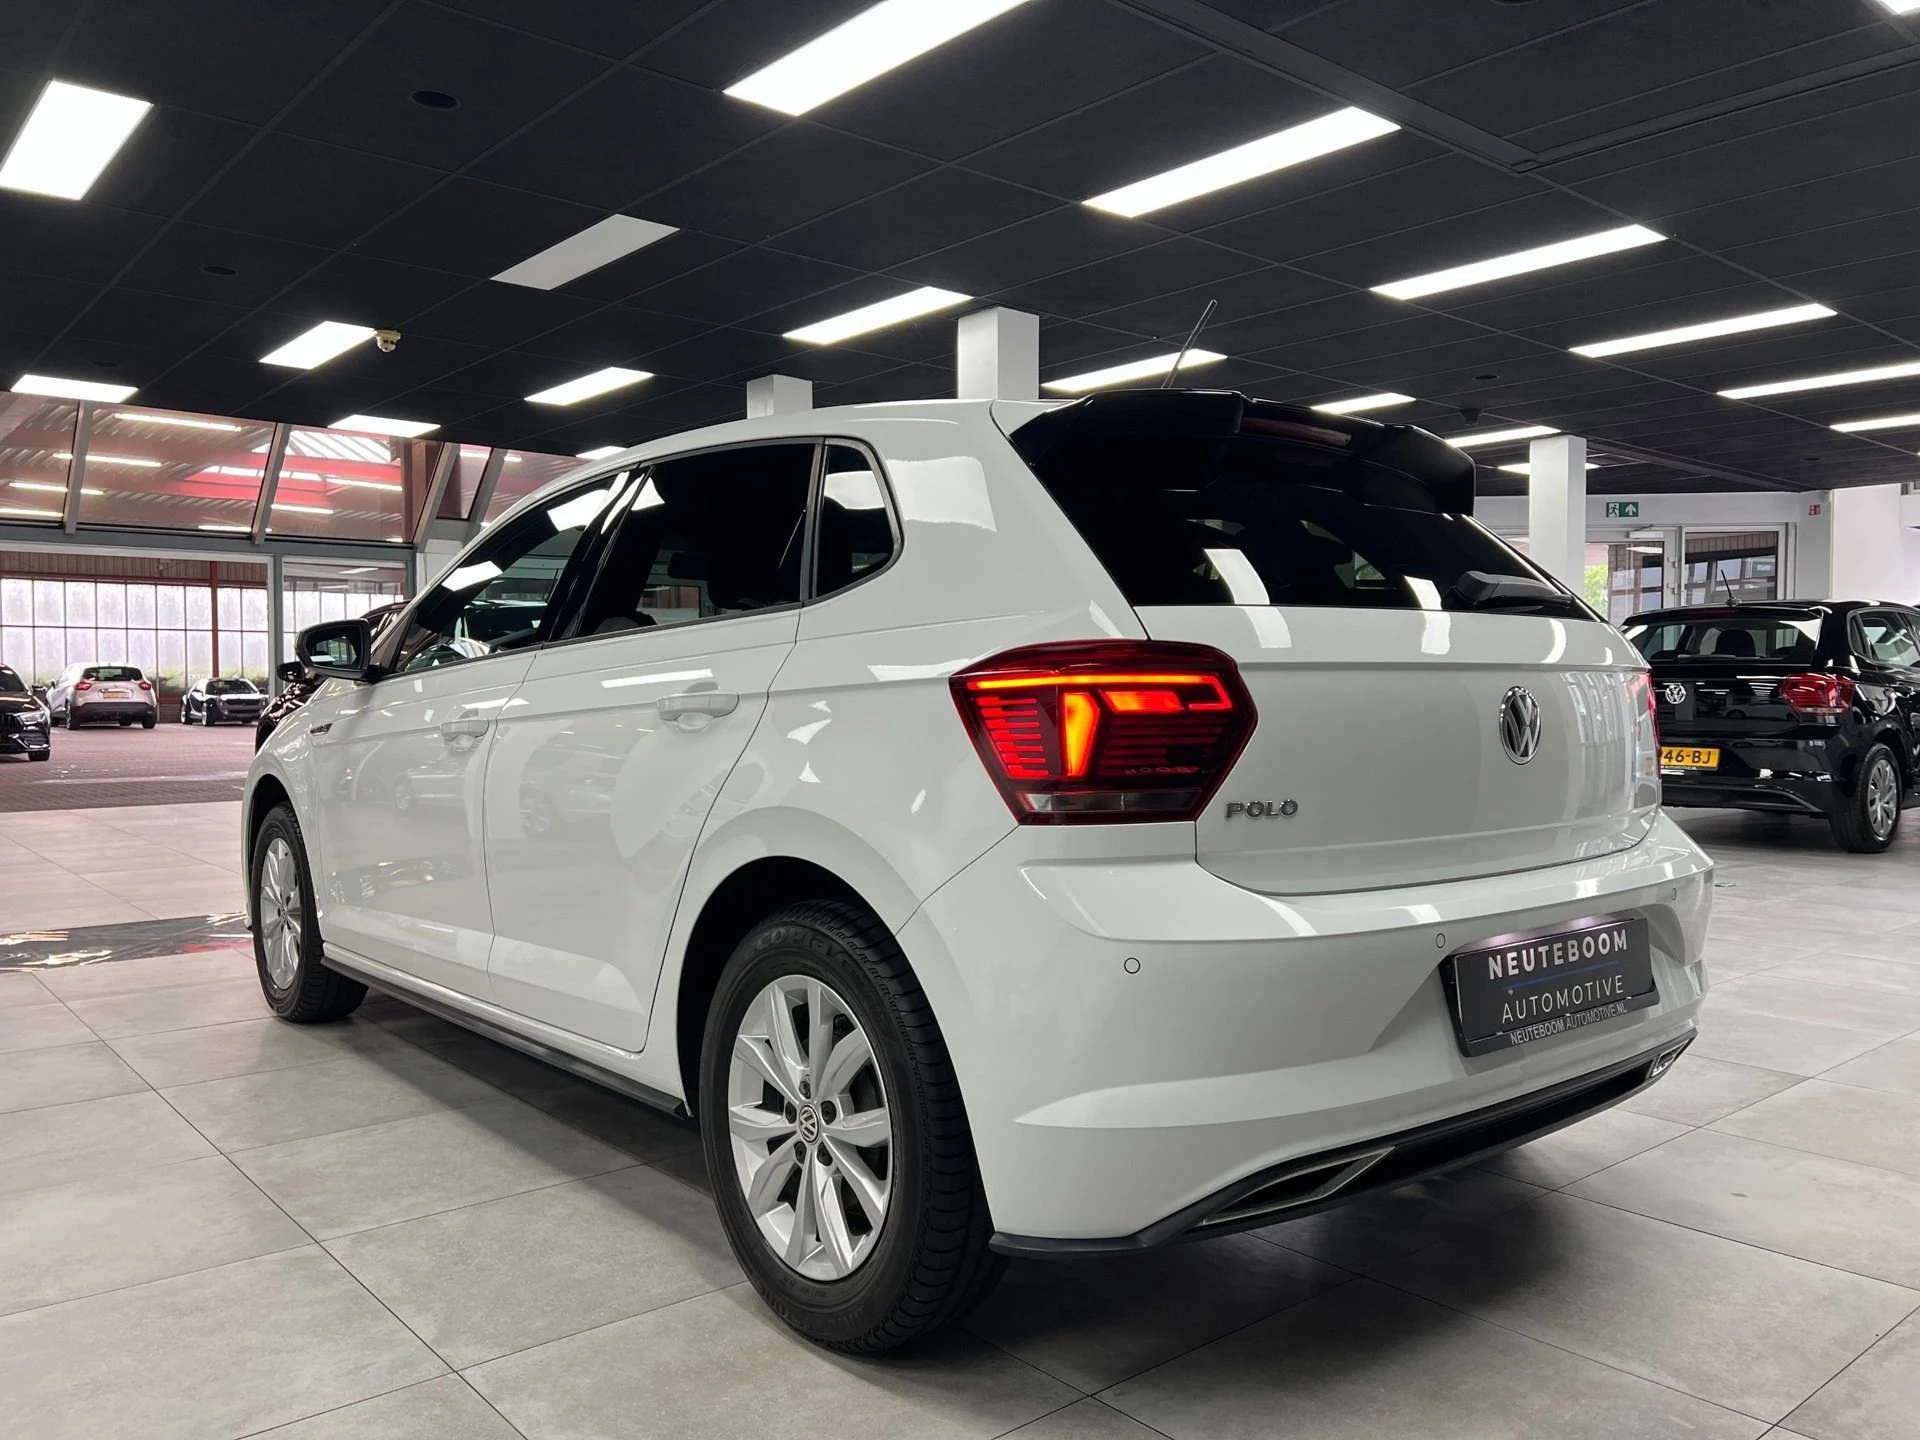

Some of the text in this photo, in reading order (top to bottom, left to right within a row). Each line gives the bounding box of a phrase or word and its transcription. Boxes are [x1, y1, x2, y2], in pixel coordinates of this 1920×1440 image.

[1660, 749, 1712, 765] 46-BJ
[1224, 798, 1299, 820] POLO
[1488, 928, 1628, 980] NEUTEBOOM
[1501, 974, 1624, 1024] AUTOMOTIVE
[1510, 1002, 1627, 1045] NEUTEBOOM AUTOMOTIVE.NL
